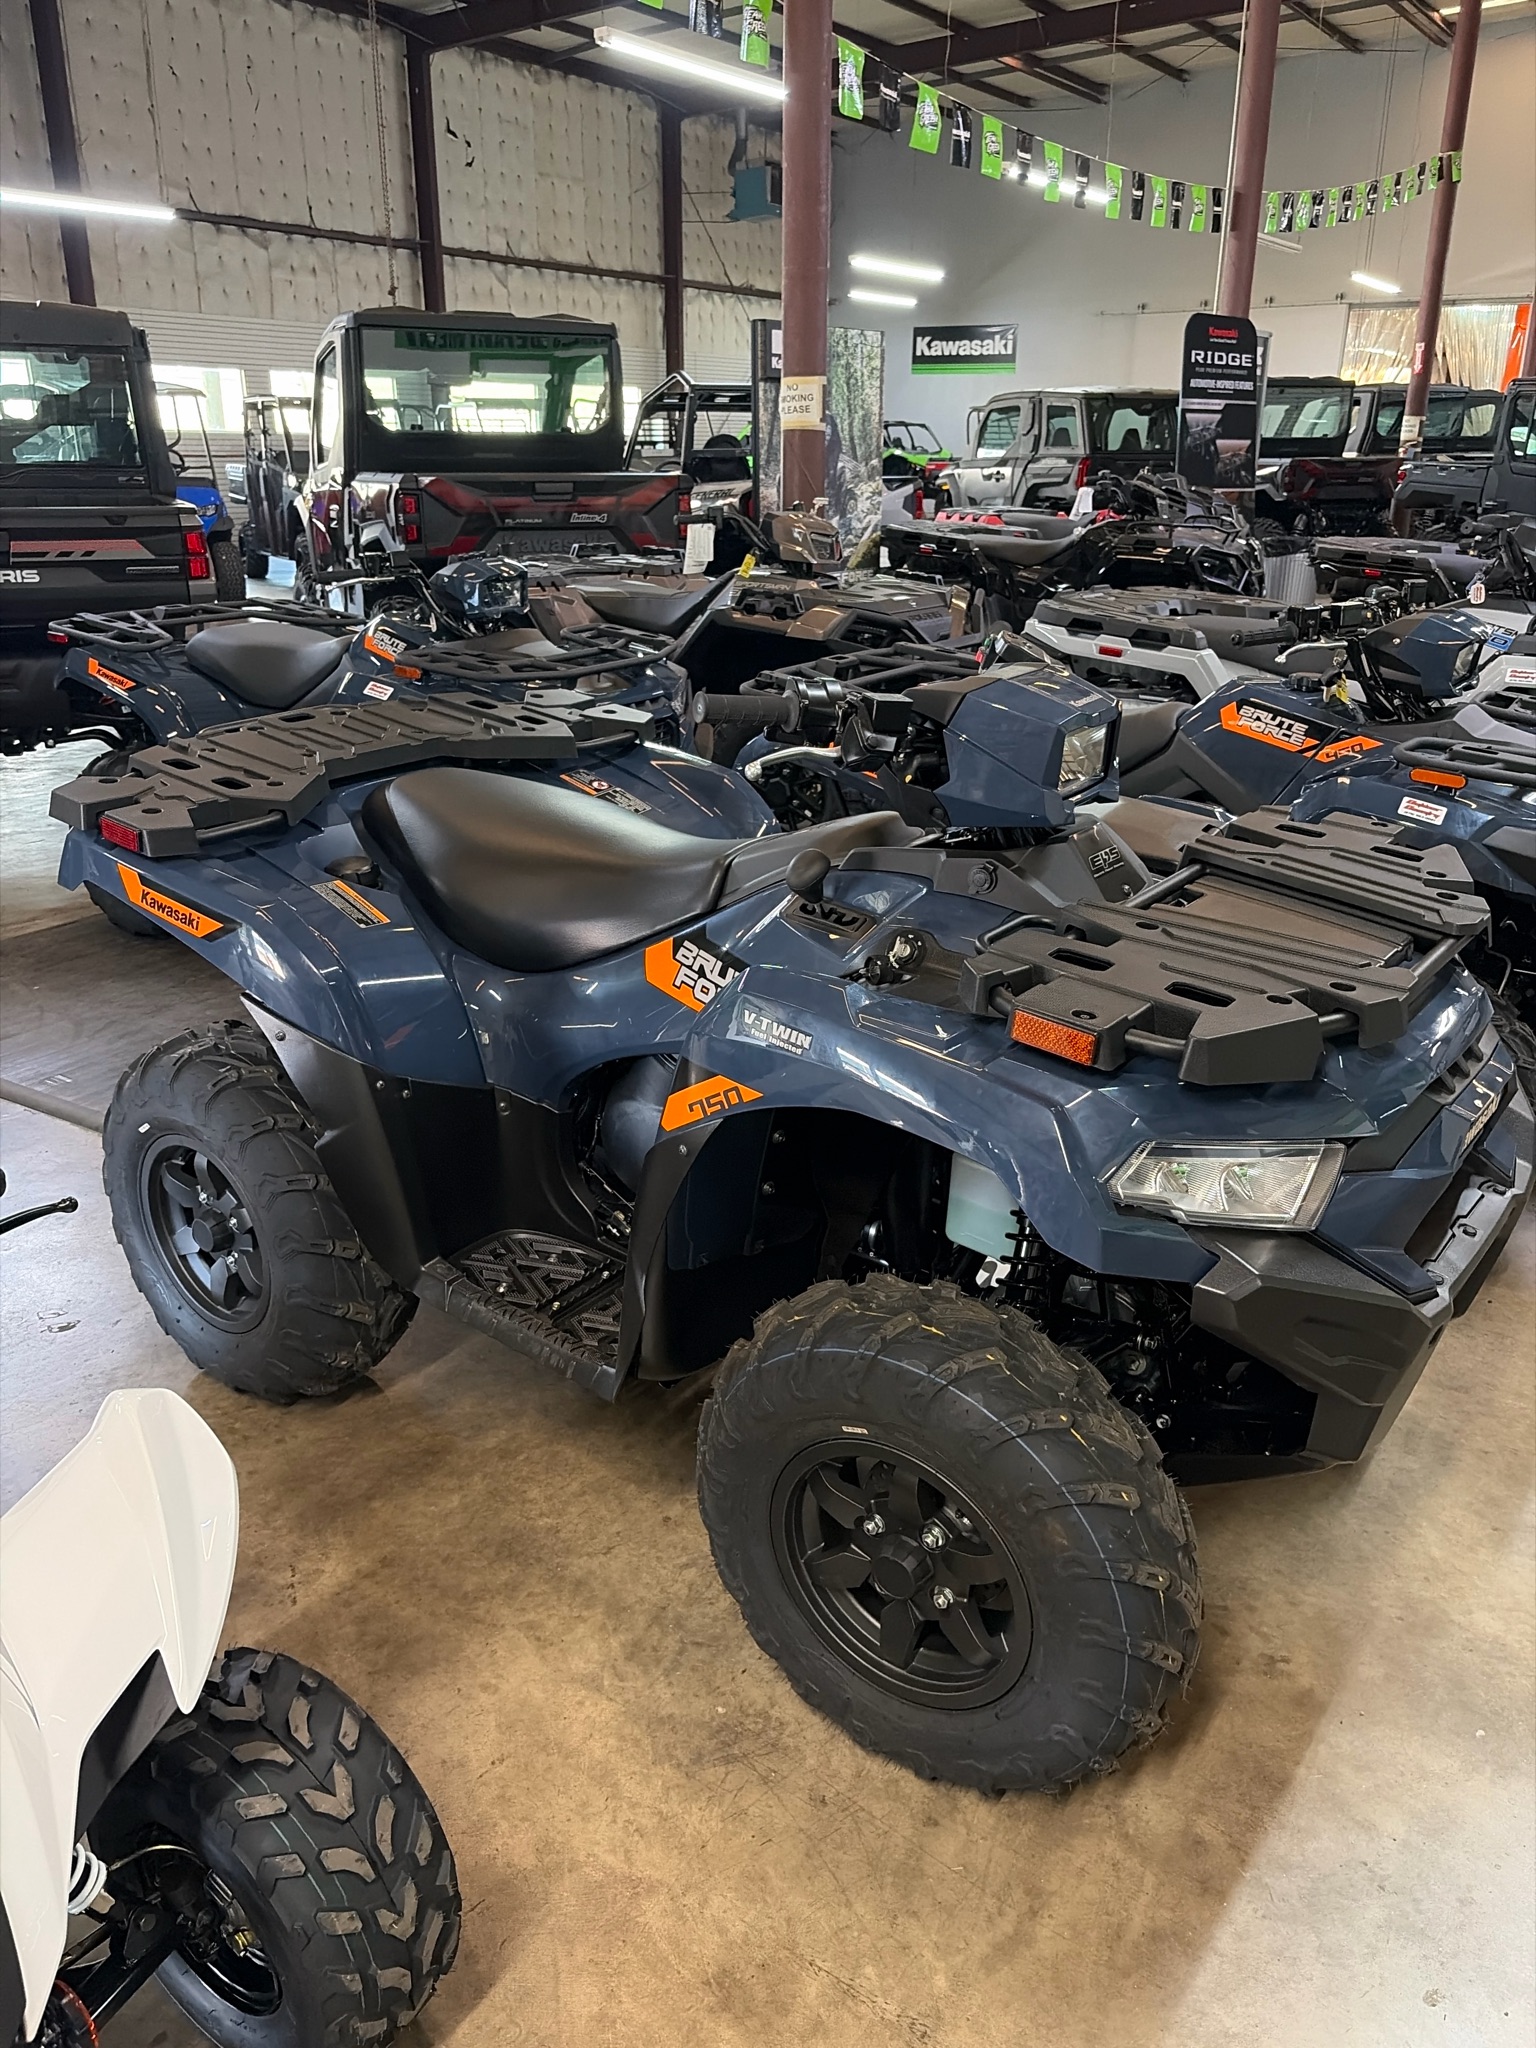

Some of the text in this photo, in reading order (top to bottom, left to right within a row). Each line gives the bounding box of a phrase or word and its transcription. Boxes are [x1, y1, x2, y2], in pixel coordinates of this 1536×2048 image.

[915, 335, 1013, 356] Kawasaki
[1191, 350, 1253, 367] RIDGE
[786, 383, 798, 391] NO
[374, 630, 407, 650] BRUTE
[95, 668, 129, 688] Kawasaki
[1237, 717, 1306, 748] FORCE
[1239, 705, 1309, 736] BRUTE
[1089, 844, 1121, 871] EPS
[140, 889, 201, 932] Kawasaki
[675, 939, 742, 988] BRU
[674, 966, 724, 1004] FO
[743, 1009, 813, 1051] V-TWIN
[750, 1027, 804, 1056] Fuel Injected
[687, 1086, 746, 1118] 750
